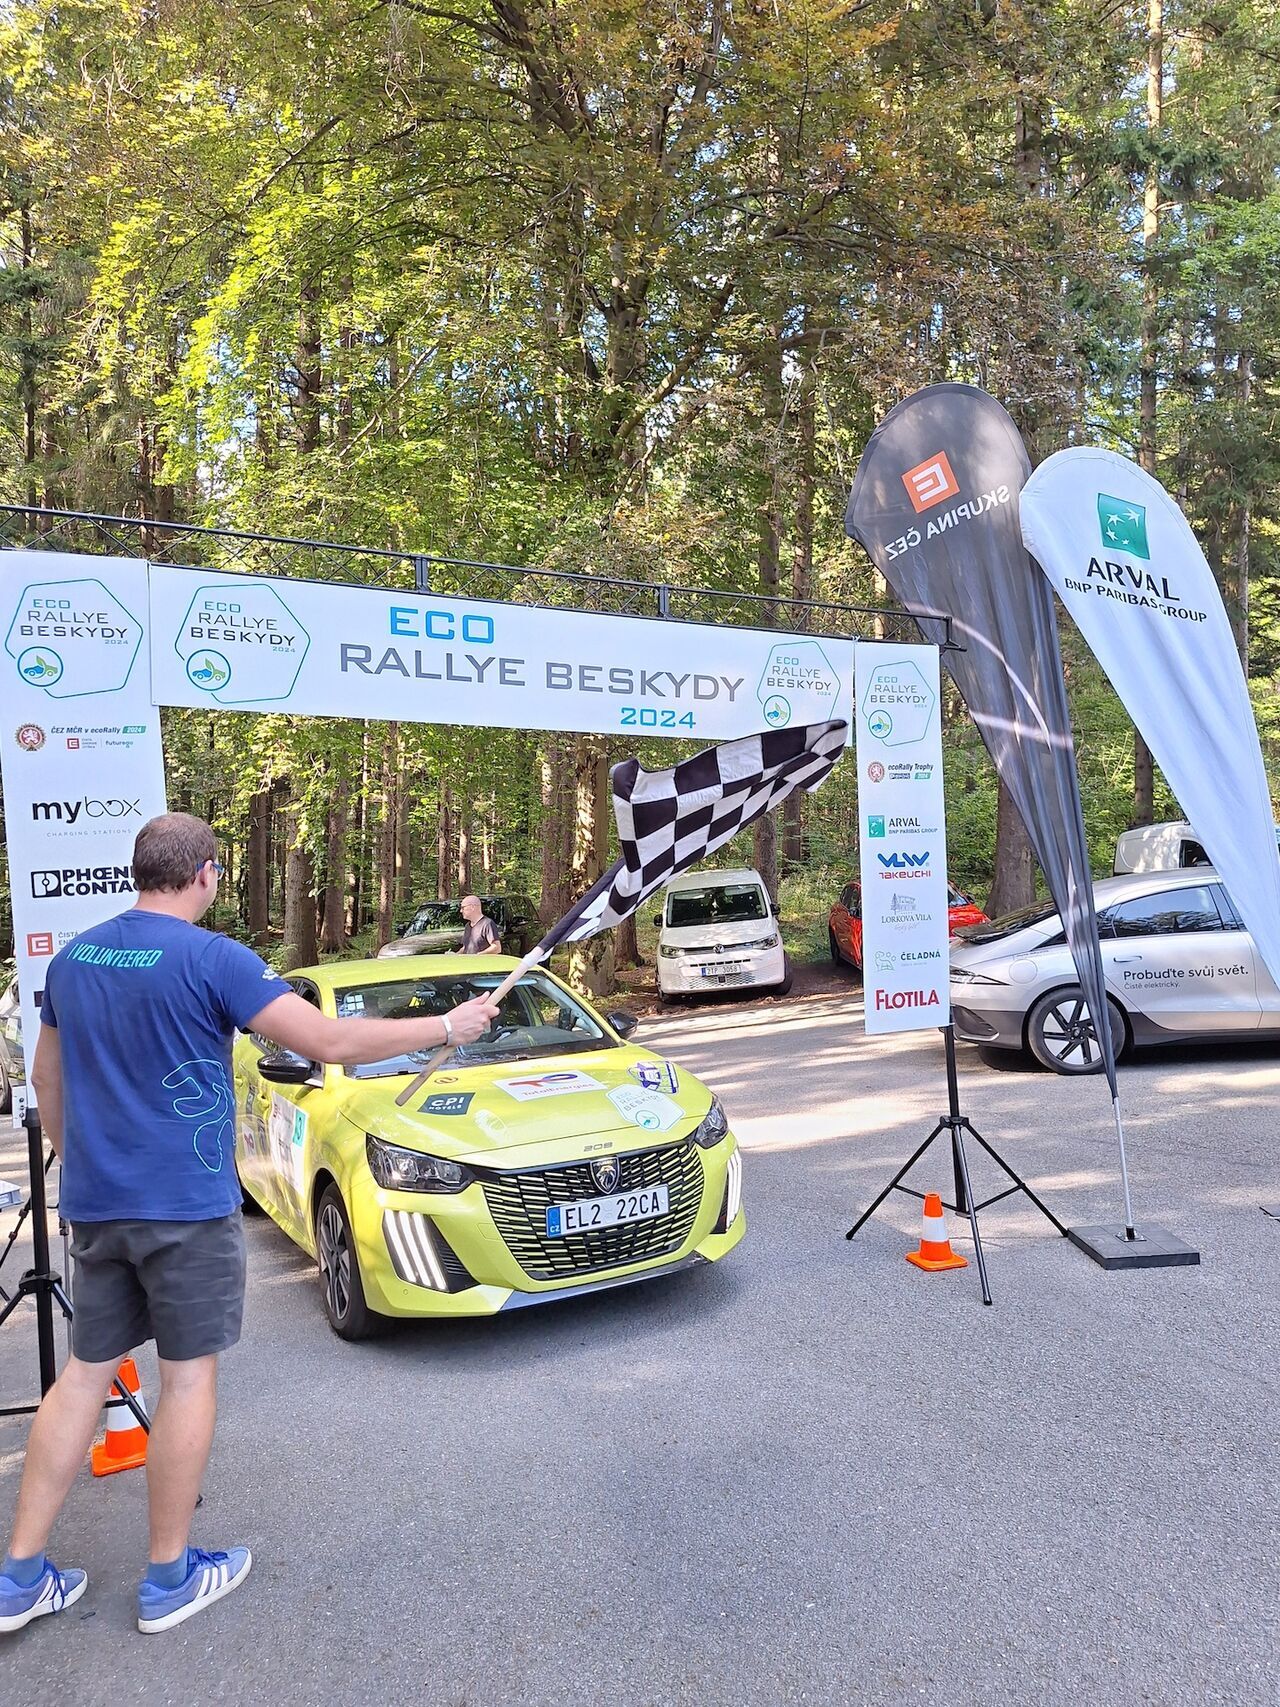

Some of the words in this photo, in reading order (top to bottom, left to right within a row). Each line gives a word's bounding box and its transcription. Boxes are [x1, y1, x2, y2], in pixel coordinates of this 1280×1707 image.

[1087, 557, 1181, 602] ARVAL
[33, 599, 71, 609] ECO
[1065, 577, 1092, 593] BNP
[1096, 585, 1158, 609] PARIBAS
[1159, 603, 1208, 623] GROUP
[204, 601, 241, 613] ECO
[27, 611, 109, 624] RALLYE
[198, 612, 278, 630] RALLYE
[390, 606, 495, 644] ECO
[20, 625, 129, 639] BESKYDY
[190, 627, 296, 647] BESKYDY
[776, 656, 800, 666] ECO
[340, 643, 526, 687] RALLYE
[546, 661, 745, 702] BESKYDY
[772, 666, 821, 678] RALLYE
[767, 678, 832, 691] BESKYDY
[874, 684, 918, 693] RALLYE
[870, 695, 928, 703] BESKYDY
[620, 707, 696, 729] 2024
[90, 726, 121, 735] ecoRally
[32, 796, 143, 824] mybox
[889, 817, 921, 827] ARVAL
[63, 880, 138, 896] CONTA
[900, 949, 941, 961] ČELADNÁ
[1124, 968, 1185, 981] Probuďte
[1188, 965, 1214, 978] svůj
[1217, 965, 1249, 976] svět.
[875, 989, 940, 1011] FLOTILA
[431, 1097, 465, 1107] CPI
[583, 1142, 613, 1152] 208
[565, 1204, 601, 1230] EL2
[616, 1191, 660, 1220] 22CA
[549, 1225, 560, 1233] CZ
